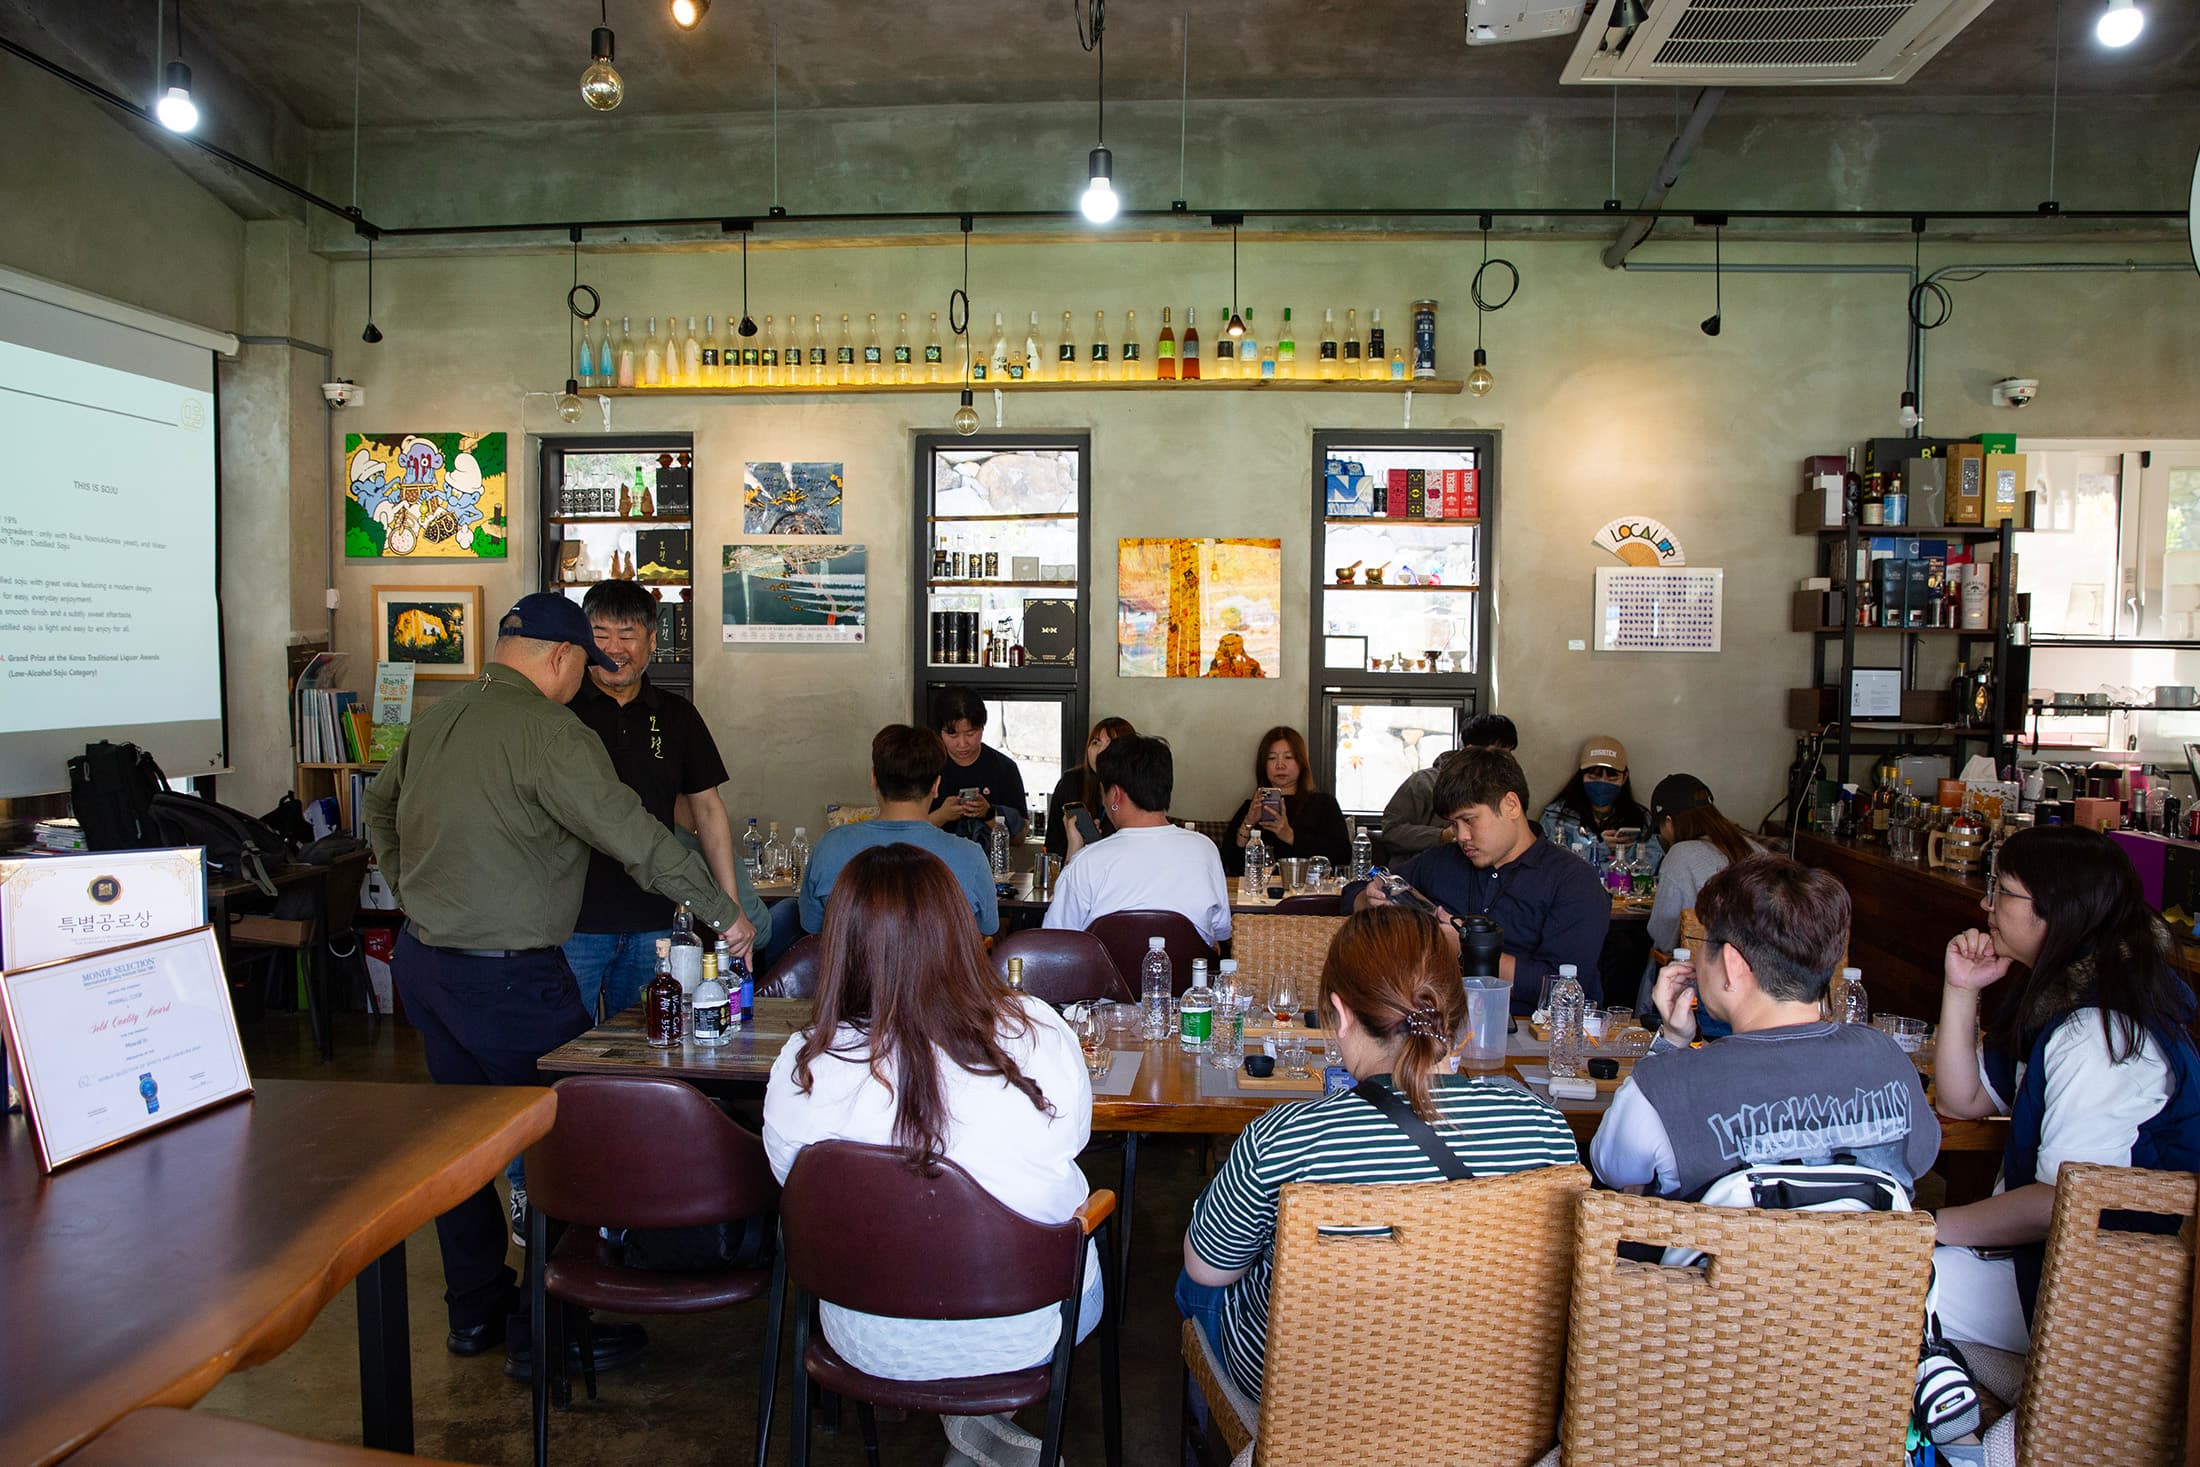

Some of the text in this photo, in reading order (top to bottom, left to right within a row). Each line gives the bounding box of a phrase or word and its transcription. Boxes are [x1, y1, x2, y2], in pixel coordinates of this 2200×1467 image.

[74, 480, 118, 494] THIS IS SOJU
[120, 654, 138, 662] Liquor
[58, 910, 152, 934] 특별공로상
[82, 966, 114, 982] MONDE
[114, 958, 155, 976] SELECTION
